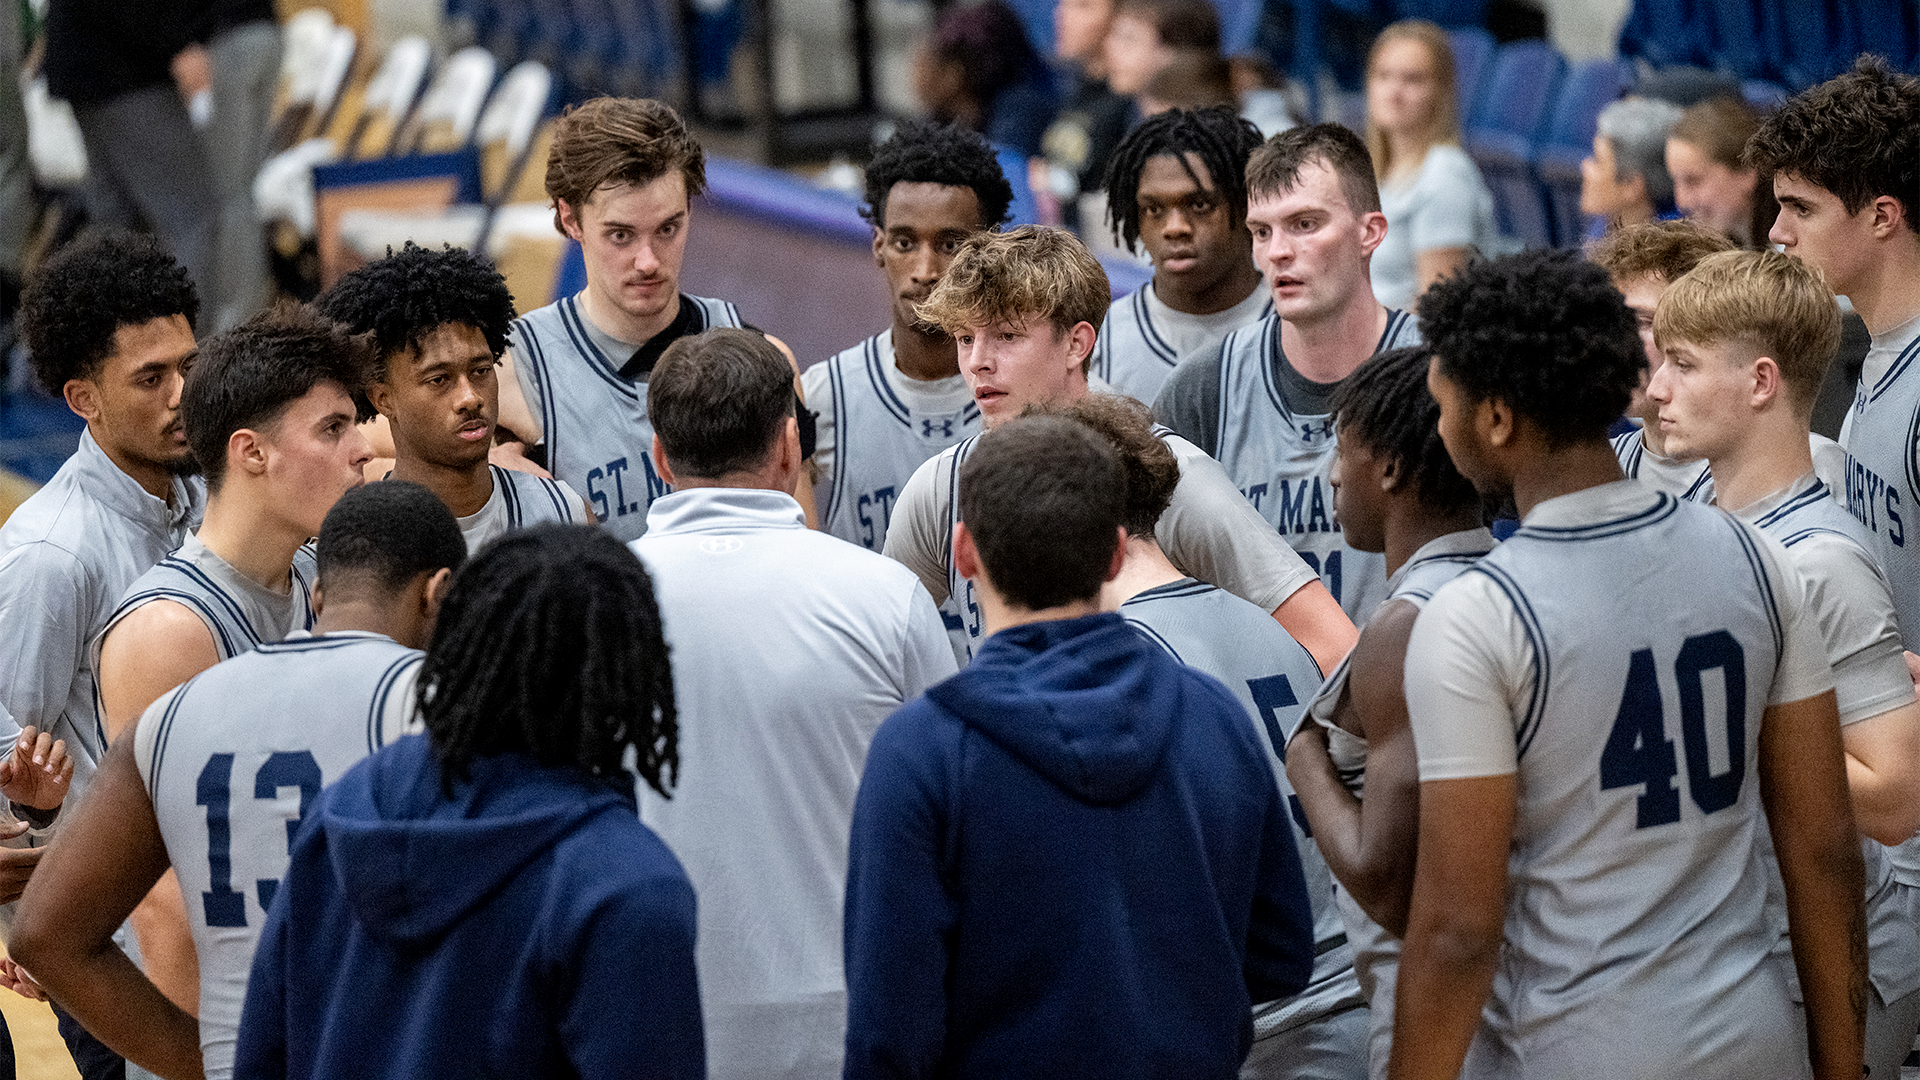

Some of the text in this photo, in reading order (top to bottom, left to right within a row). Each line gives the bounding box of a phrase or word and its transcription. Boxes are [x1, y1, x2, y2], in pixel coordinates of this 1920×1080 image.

[586, 456, 638, 523] ST.
[1600, 629, 1747, 829] 40
[196, 750, 322, 927] 13
